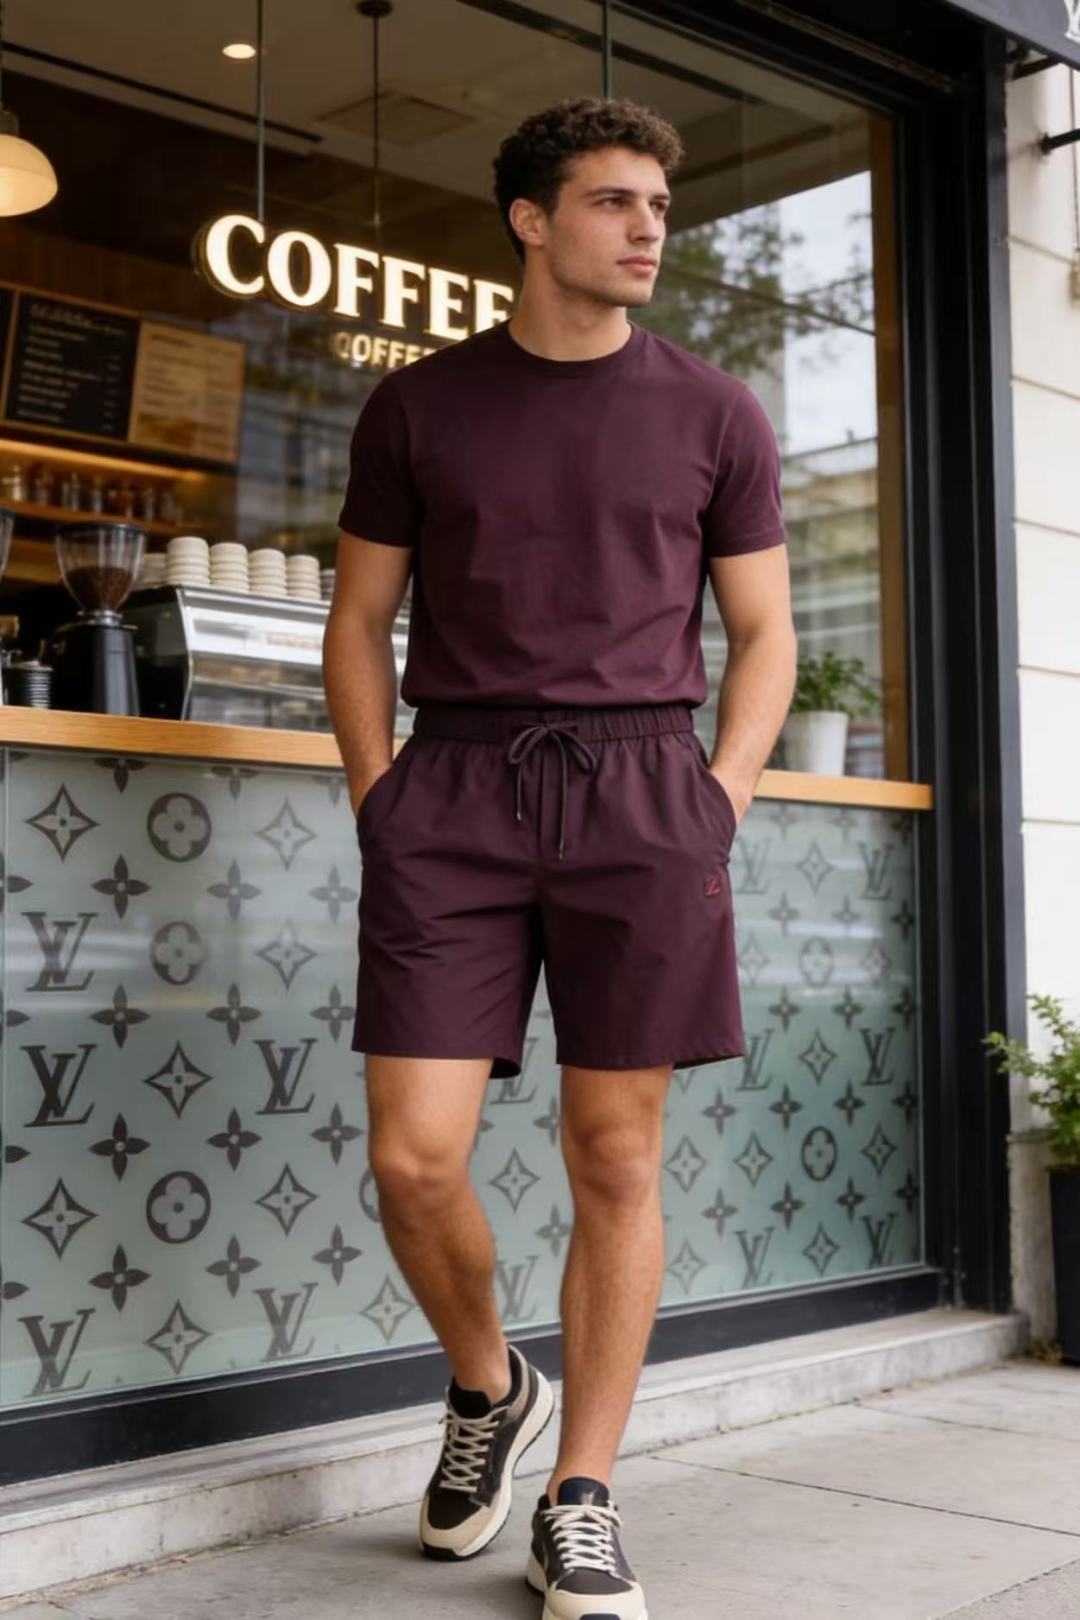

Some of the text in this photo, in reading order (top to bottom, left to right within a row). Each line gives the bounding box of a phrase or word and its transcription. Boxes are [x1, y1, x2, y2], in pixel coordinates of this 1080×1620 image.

[21, 911, 98, 992] LV
[20, 1043, 98, 1128] LV
[253, 1038, 318, 1115] LV
